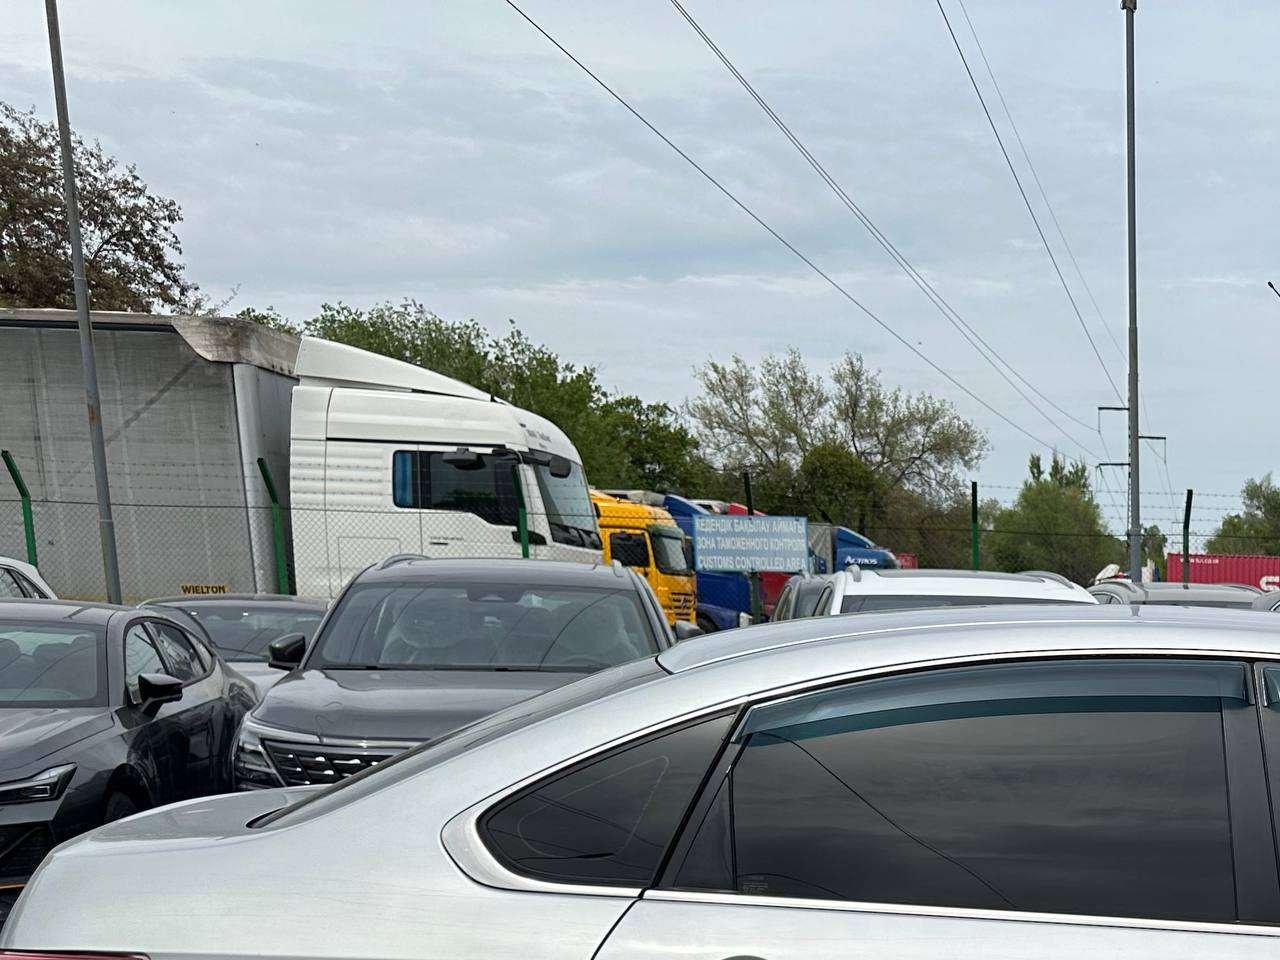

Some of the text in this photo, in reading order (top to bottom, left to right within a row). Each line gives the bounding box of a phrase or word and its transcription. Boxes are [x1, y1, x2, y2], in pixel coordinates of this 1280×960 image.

[698, 555, 806, 571] CUSTOMS CONTROLLED AREA
[181, 585, 226, 594] WIELTON
